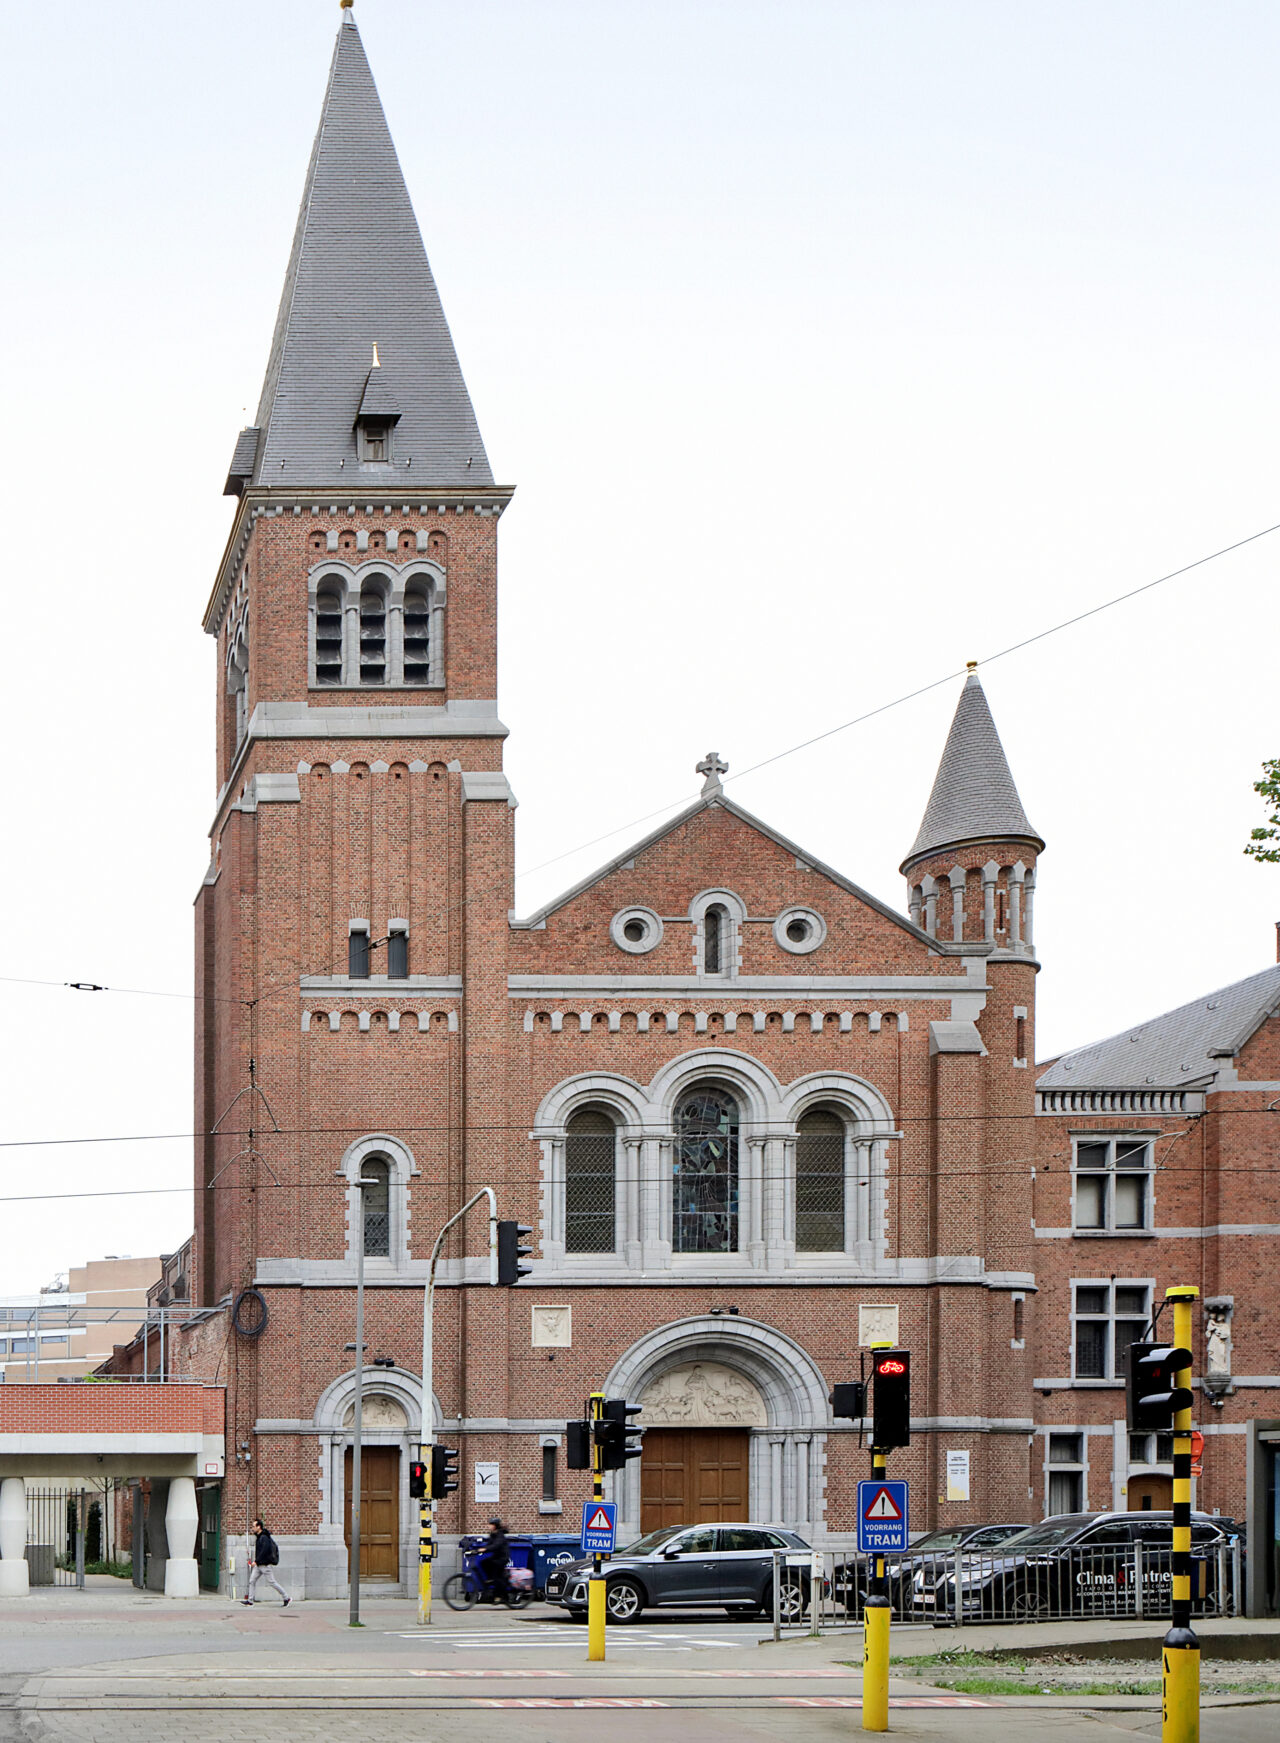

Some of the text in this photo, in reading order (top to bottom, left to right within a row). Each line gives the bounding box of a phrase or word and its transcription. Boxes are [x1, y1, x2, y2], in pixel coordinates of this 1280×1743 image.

[587, 1539, 611, 1548] TRAM
[866, 1534, 901, 1545] TRAM
[546, 1554, 575, 1567] renewi
[1076, 1571, 1115, 1585] Clima
